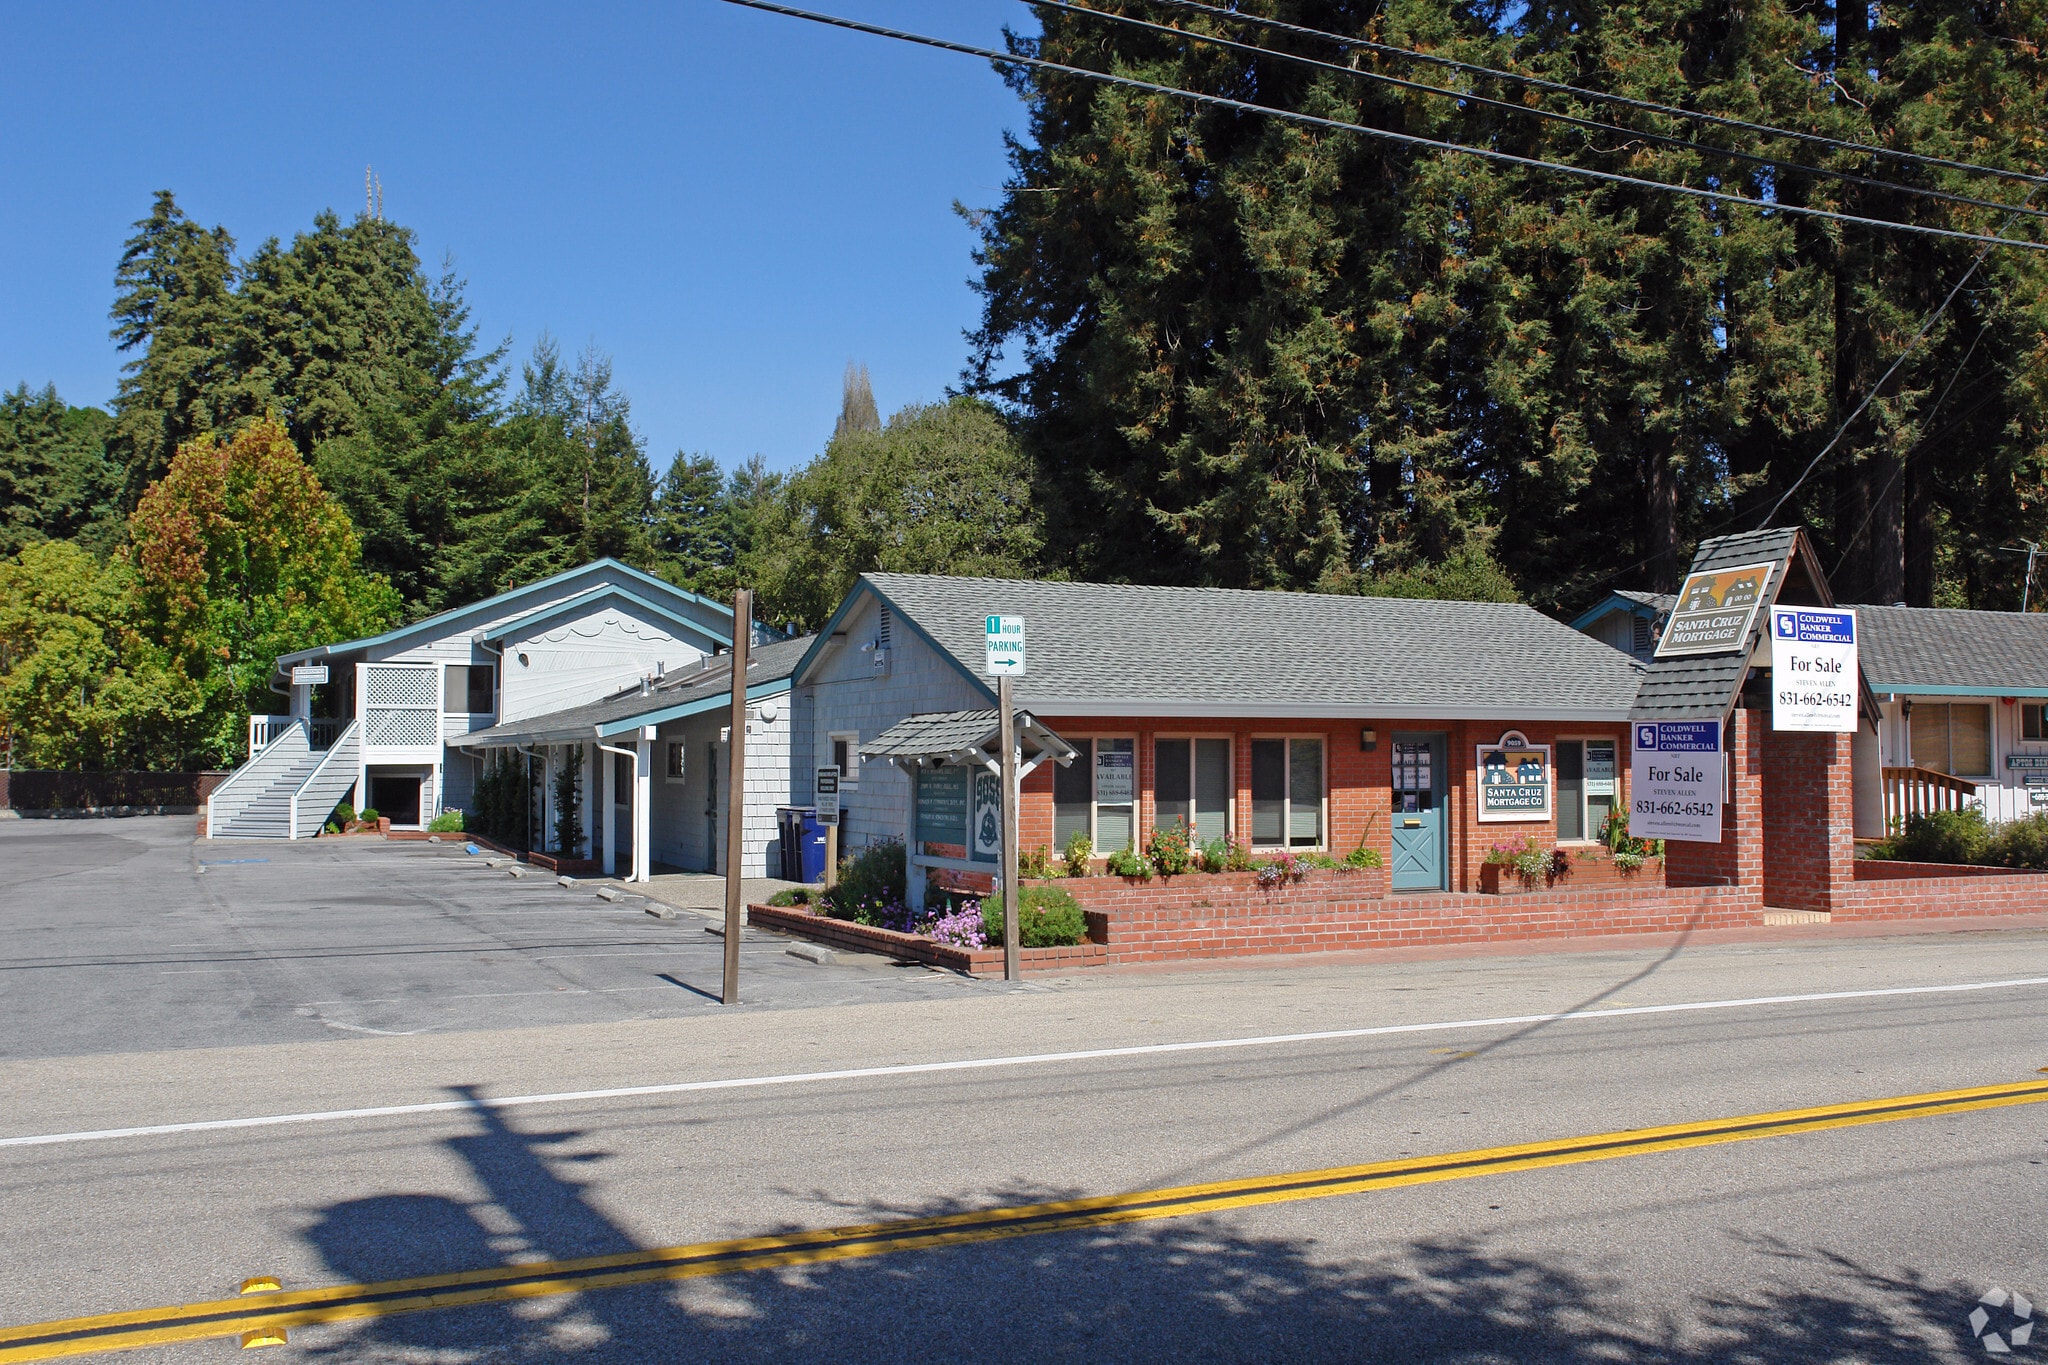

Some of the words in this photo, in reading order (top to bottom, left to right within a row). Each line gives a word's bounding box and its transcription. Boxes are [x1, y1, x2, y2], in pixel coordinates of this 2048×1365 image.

[1674, 619, 1710, 632] SANTA
[1711, 615, 1743, 628] CRUZ
[1800, 614, 1842, 625] COLDWELL
[991, 618, 995, 633] 1
[1002, 624, 1021, 634] HOUR
[1800, 623, 1831, 633] BANKER
[1671, 628, 1736, 644] MORTGAGE
[1800, 632, 1852, 643] COMMERCIAL
[988, 640, 1022, 652] PARKING
[1791, 655, 1812, 671] For
[1815, 657, 1842, 673] Sale
[1779, 691, 1851, 707] 831-662-6542
[1660, 725, 1706, 733] COLDWELL
[1660, 743, 1716, 751] COMMERCIAL
[2011, 758, 2033, 767] APTOS
[1648, 766, 1670, 781] For
[1674, 767, 1703, 782] Sale
[1487, 788, 1516, 797] SANTA
[1518, 788, 1542, 796] CRUZ
[1677, 789, 1696, 797] ALLEN
[1487, 797, 1530, 806] MORTGAGE
[1530, 797, 1542, 805] CO
[1636, 800, 1713, 816] 831-662-6542
